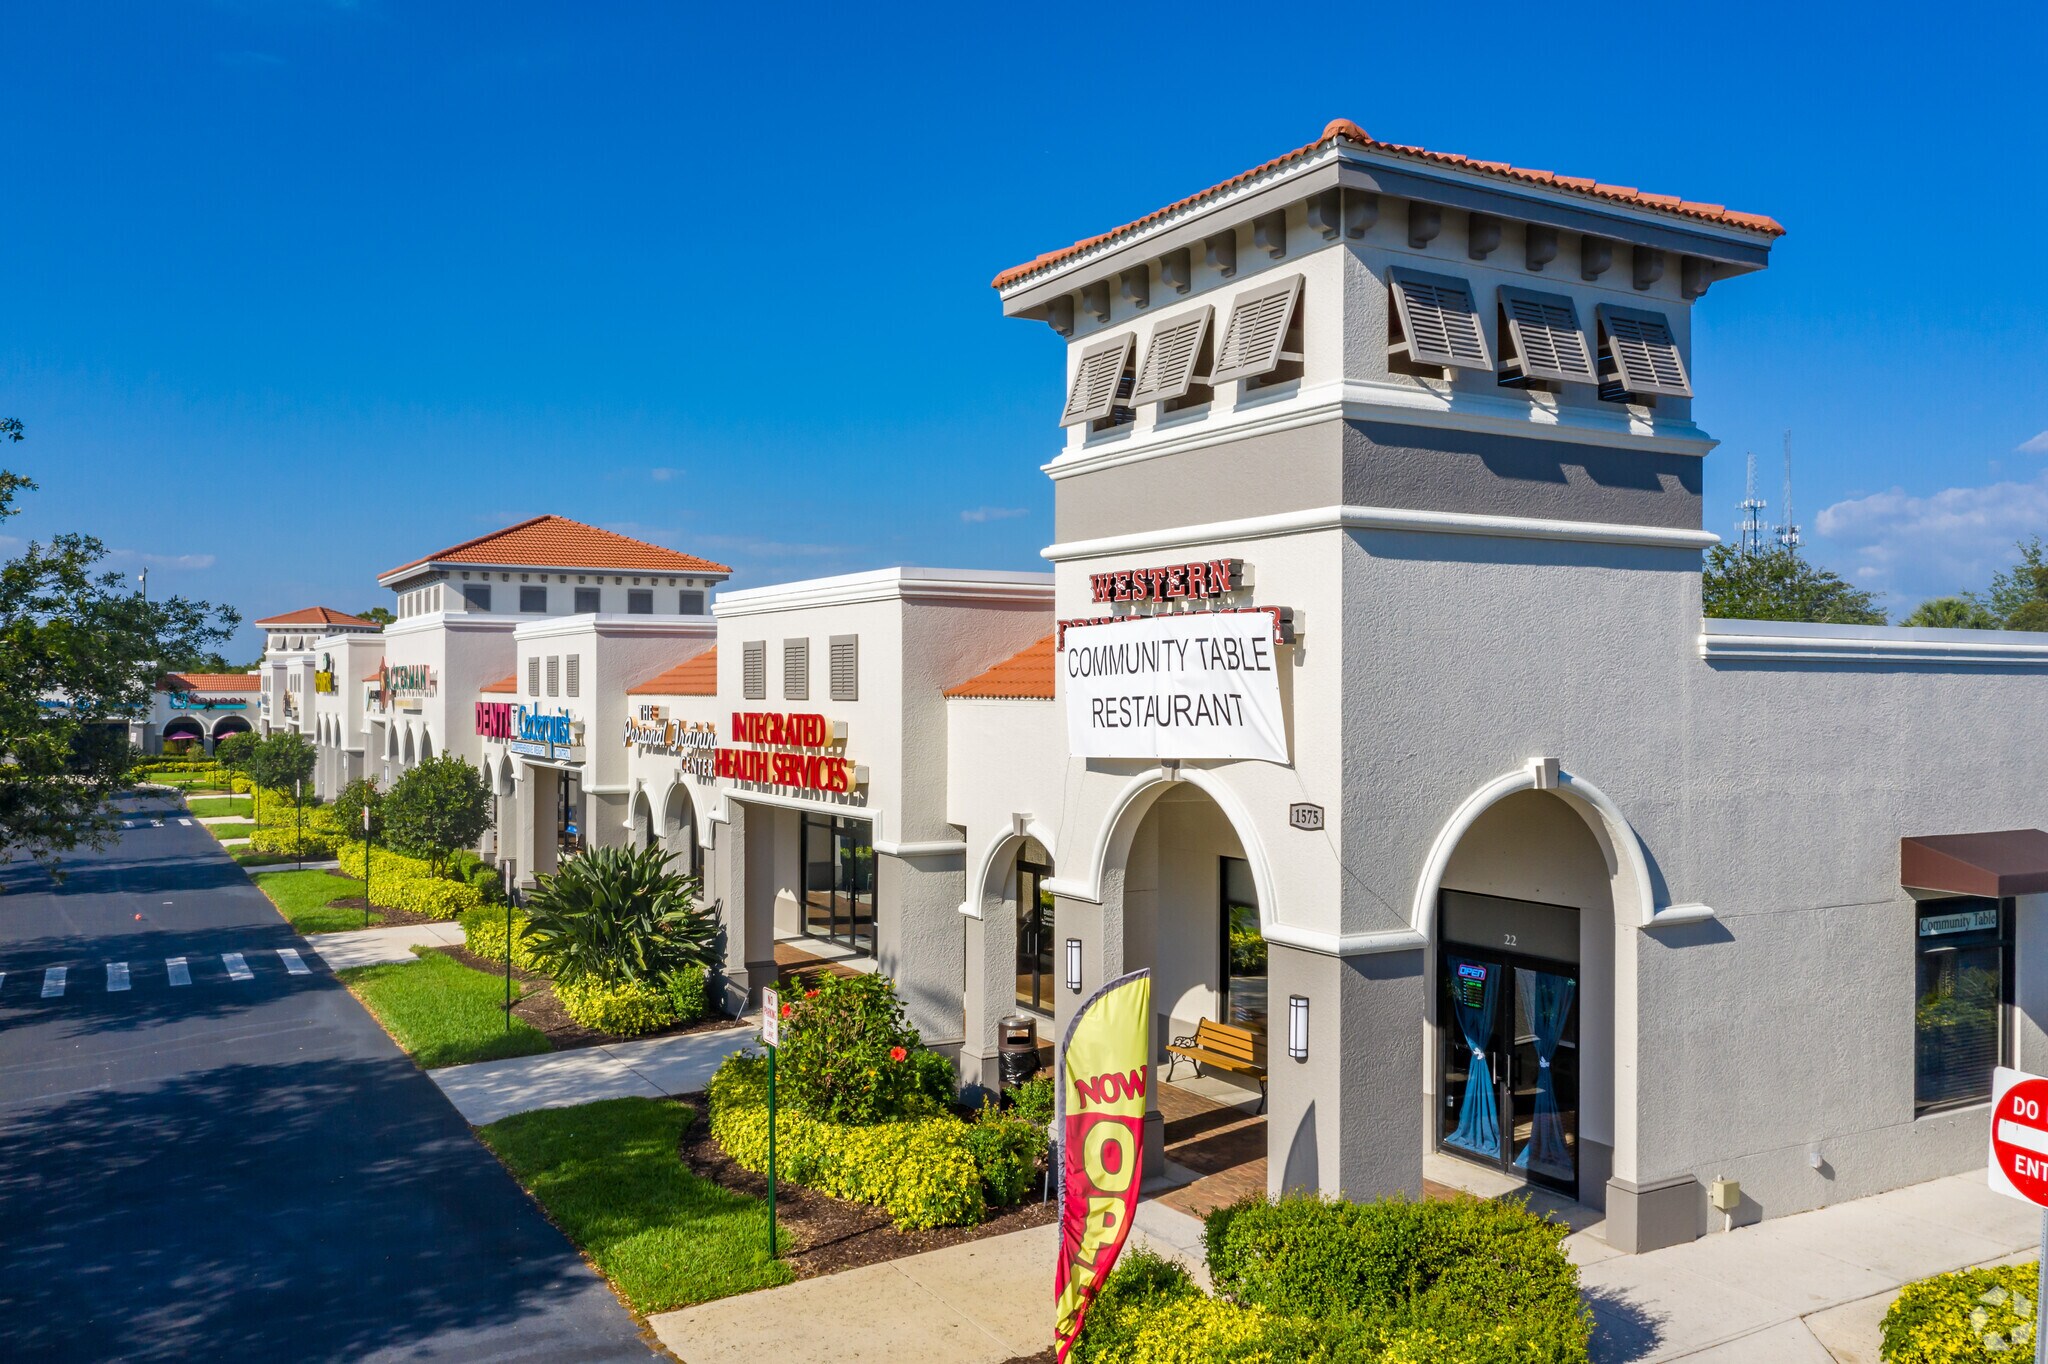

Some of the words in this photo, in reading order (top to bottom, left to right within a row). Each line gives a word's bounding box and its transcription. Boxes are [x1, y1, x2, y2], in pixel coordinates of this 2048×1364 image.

[1089, 558, 1232, 604] WESTERN
[1068, 638, 1191, 678] COMMUNITY
[1195, 636, 1271, 672] TABLE
[638, 705, 653, 721] THE
[1092, 693, 1245, 728] RESTAURANT
[622, 716, 668, 747] Personal
[732, 712, 826, 747] INTEGRATED
[680, 756, 714, 777] CENTER
[715, 748, 767, 782] HEALTH
[773, 752, 848, 793] SERVICES
[1294, 807, 1319, 825] 1575
[1920, 914, 1971, 931] Community
[1973, 911, 1996, 926] Table
[1503, 933, 1517, 946] 22
[1459, 967, 1484, 978] OPEN
[1074, 1064, 1147, 1109] NOW
[2013, 1096, 2039, 1120] DO
[1055, 1121, 1137, 1362] OPE
